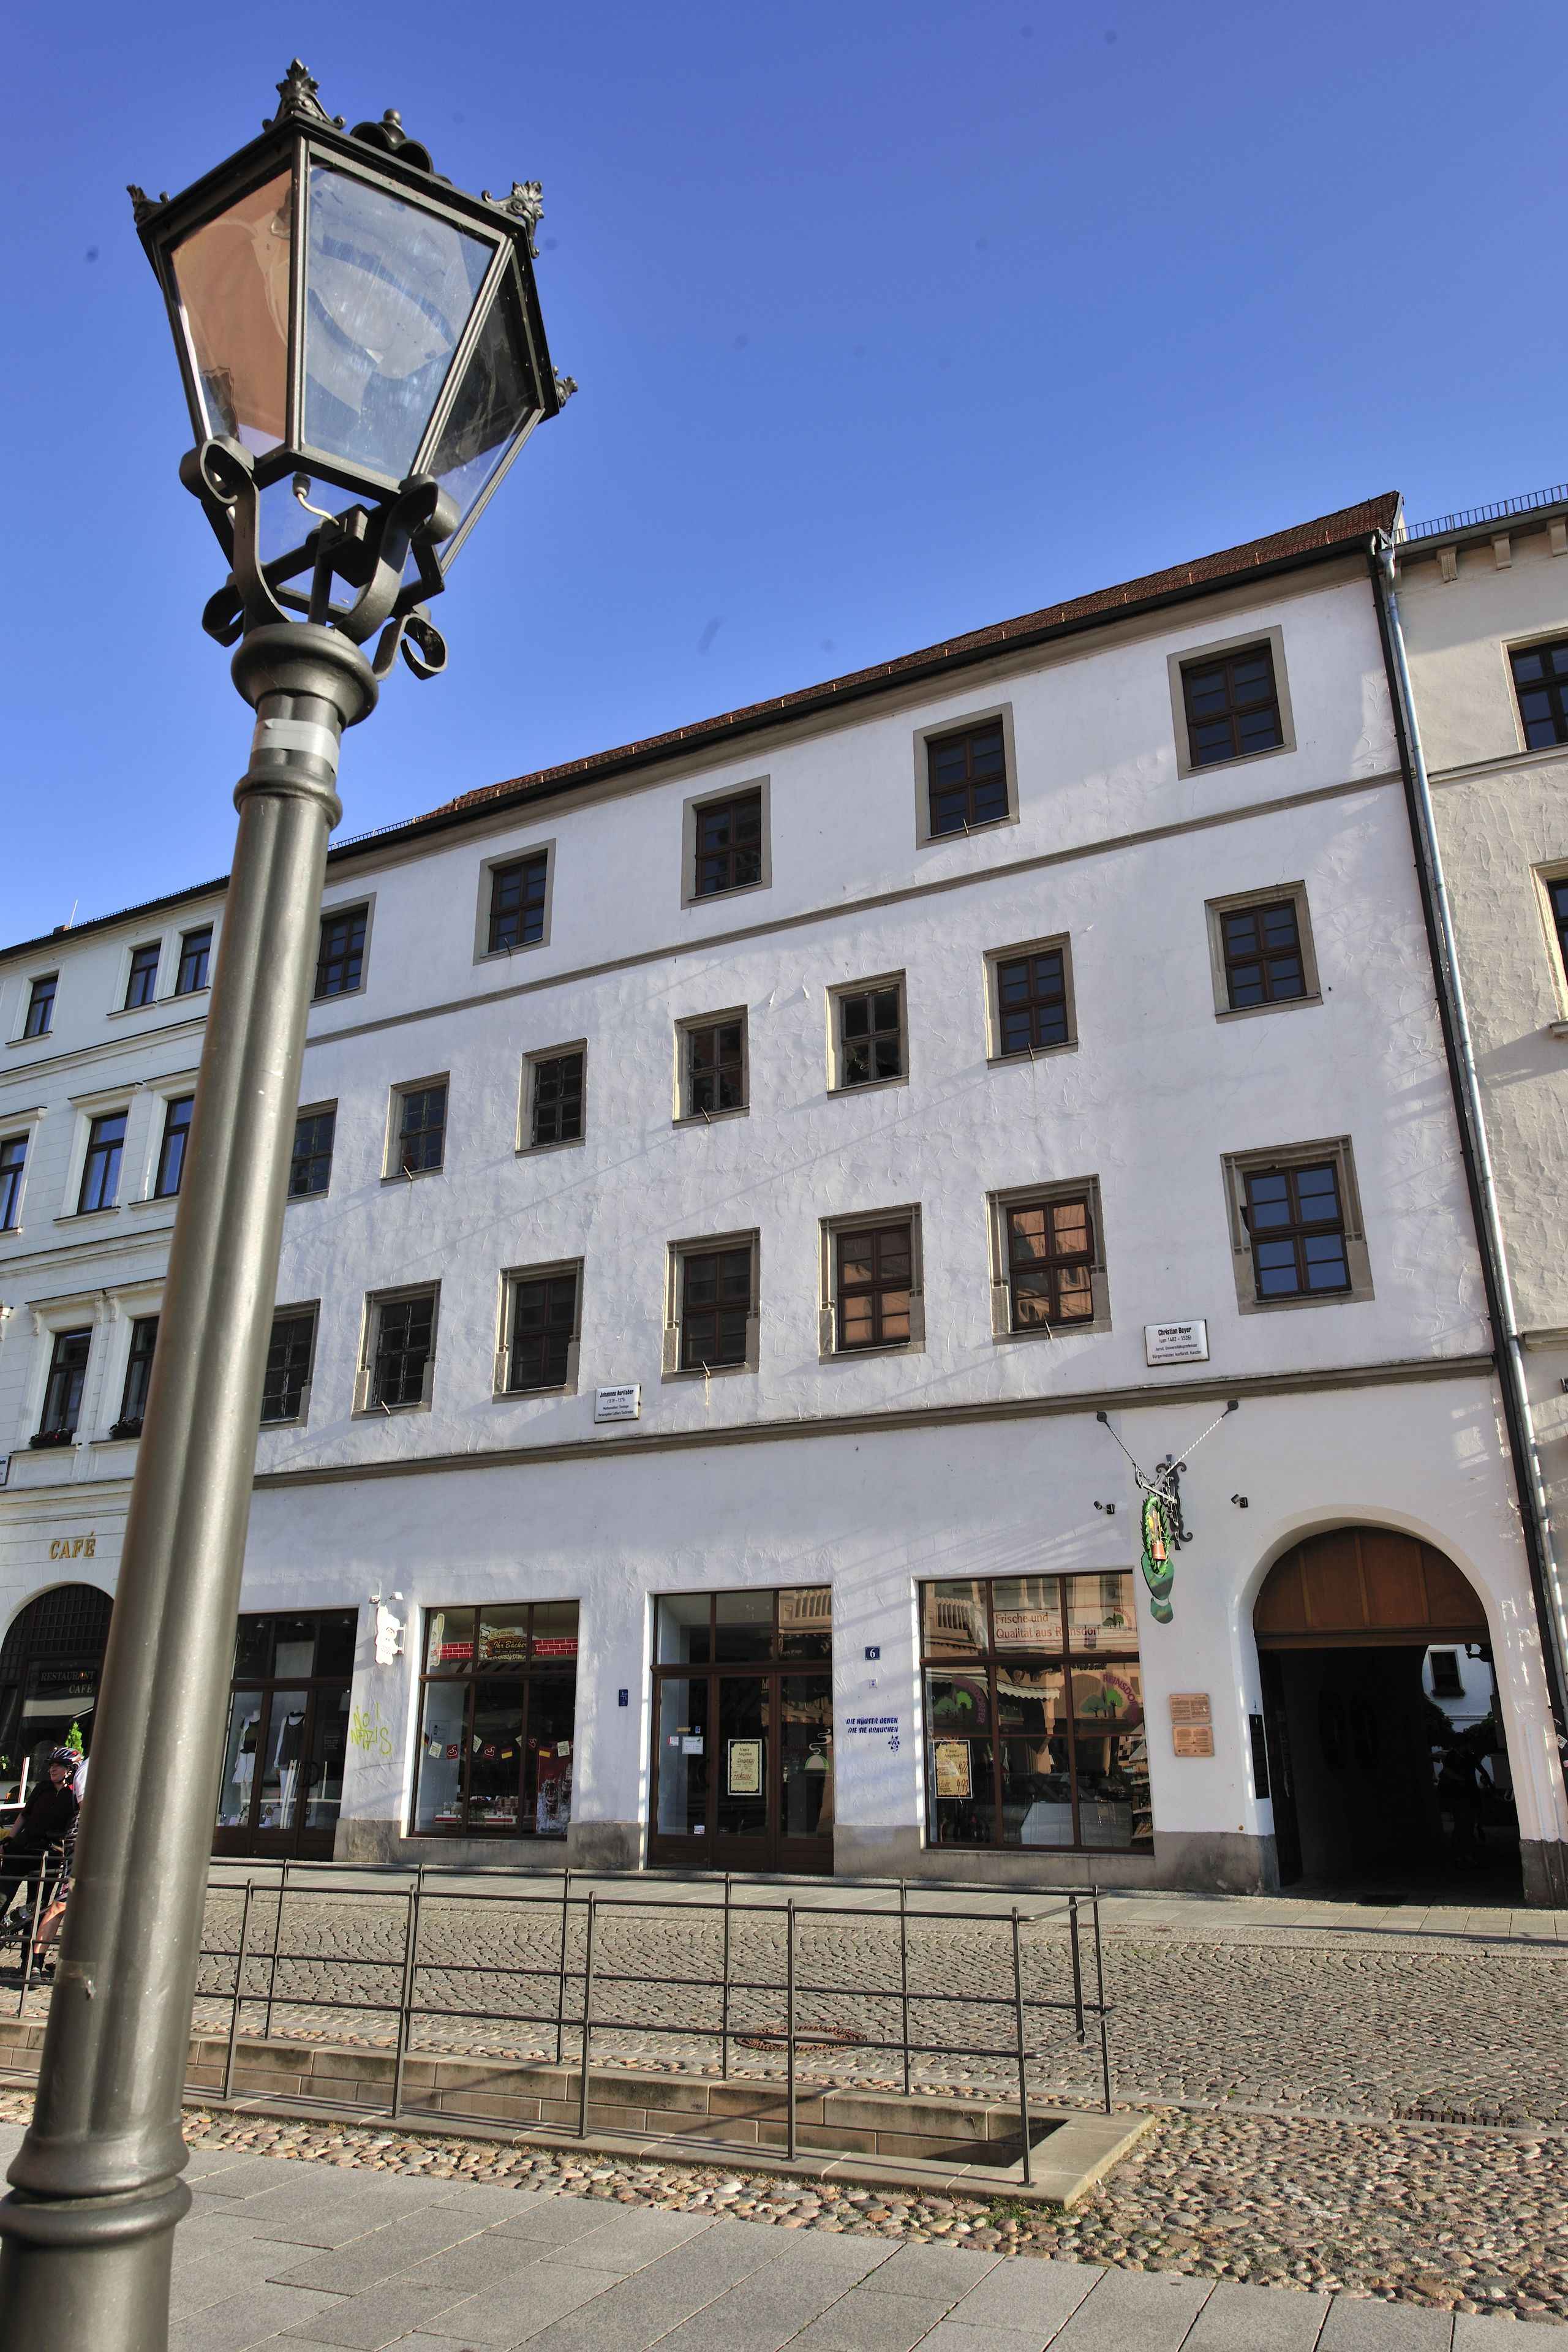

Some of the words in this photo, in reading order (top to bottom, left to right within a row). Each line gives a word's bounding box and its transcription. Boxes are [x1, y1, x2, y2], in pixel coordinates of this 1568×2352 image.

[49, 1532, 96, 1559] CAFÉ
[995, 1613, 1028, 1624] Frische
[1030, 1612, 1049, 1623] und
[996, 1627, 1032, 1639] Qualität
[1036, 1627, 1052, 1637] aus
[1055, 1624, 1101, 1636] Rnsdorf
[505, 1640, 527, 1649] Bäcker
[870, 1648, 876, 1658] 6
[40, 1670, 96, 1681] RESTAURANT
[69, 1682, 94, 1694] CAFÉ
